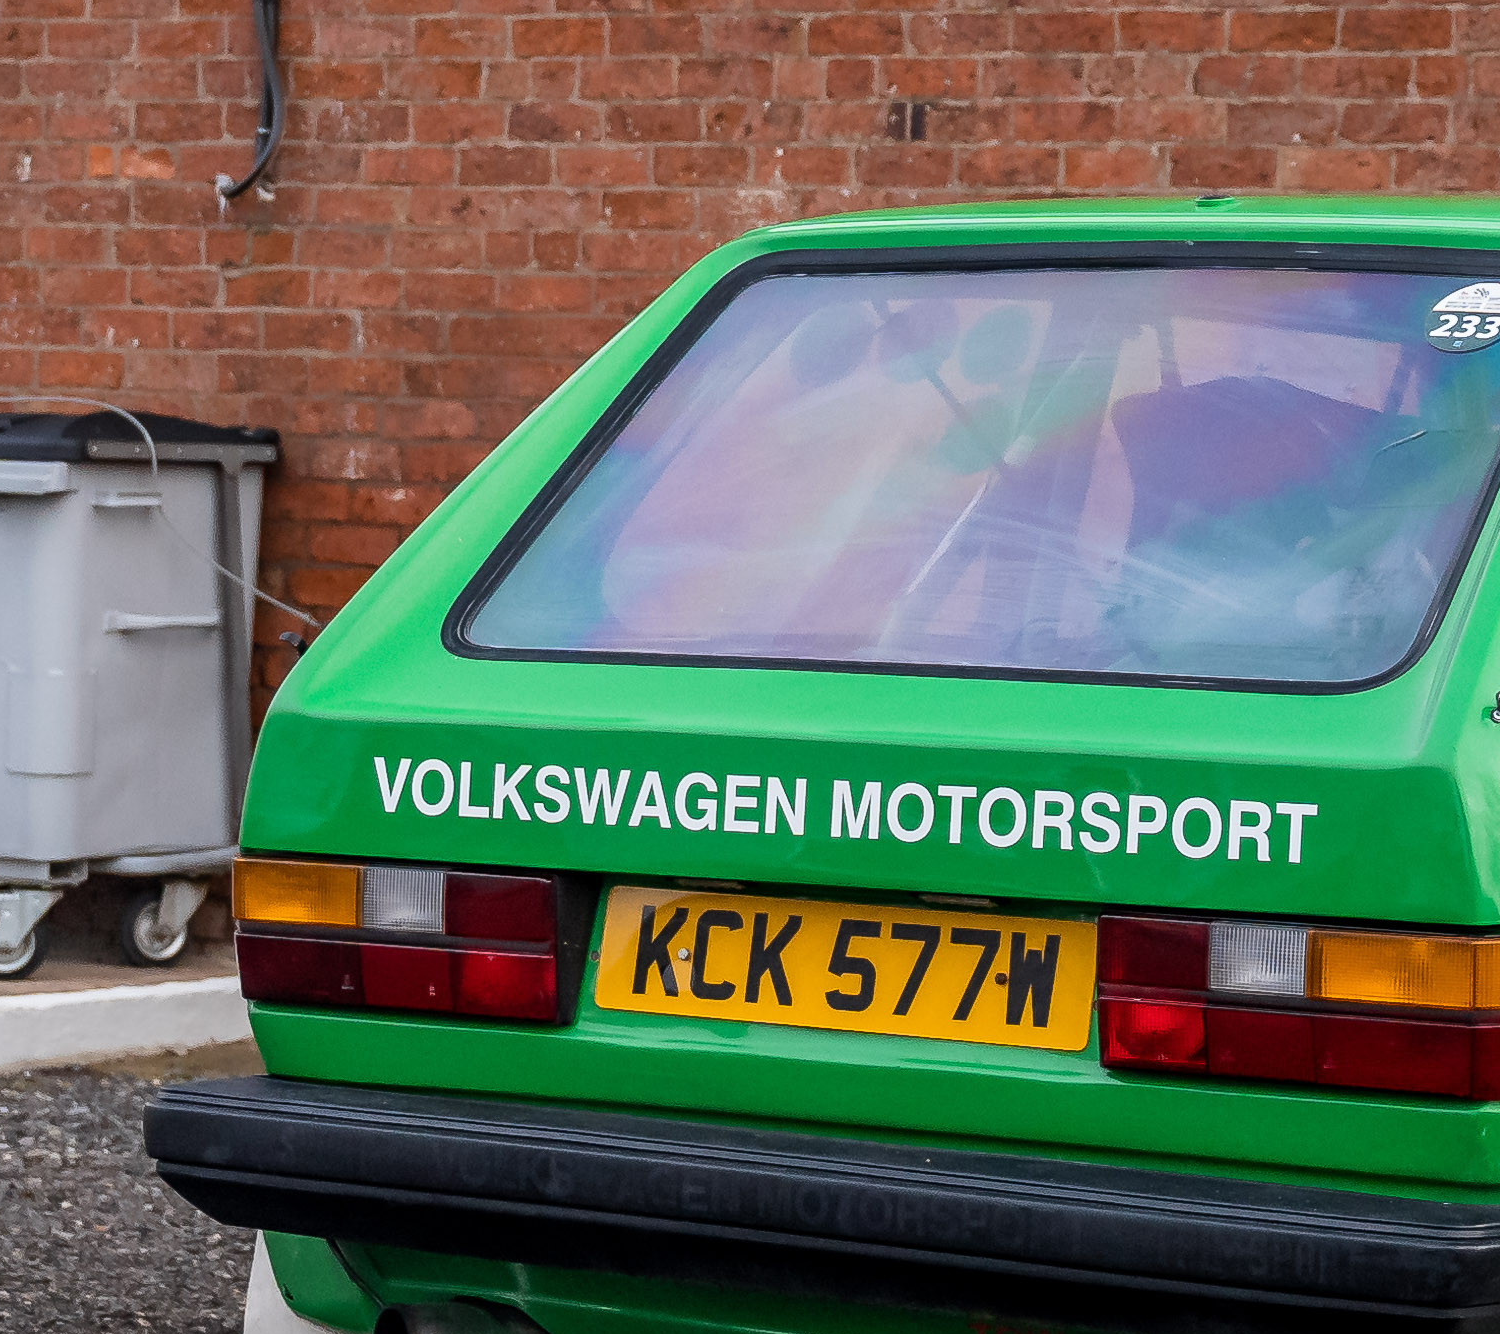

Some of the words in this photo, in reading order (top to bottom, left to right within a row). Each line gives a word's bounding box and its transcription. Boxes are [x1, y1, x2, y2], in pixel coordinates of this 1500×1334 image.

[373, 756, 808, 836] VOLKSWAGEN
[830, 779, 1318, 865] MOTORSPORT
[631, 905, 803, 1007] KCK
[825, 918, 1061, 1028] 577W
